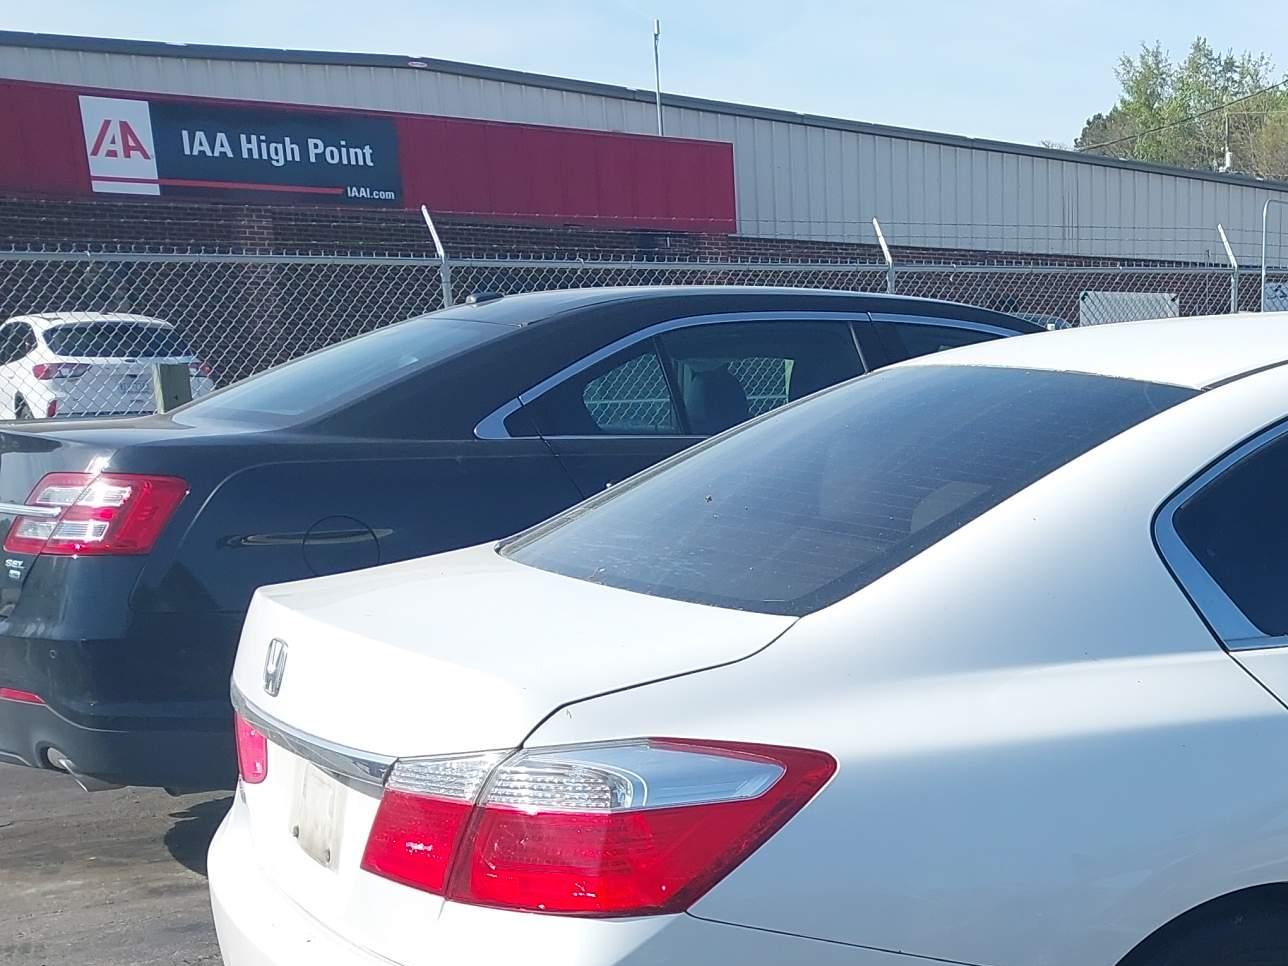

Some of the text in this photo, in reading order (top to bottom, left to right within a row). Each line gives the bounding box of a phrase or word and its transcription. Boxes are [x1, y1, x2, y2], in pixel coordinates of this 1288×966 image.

[181, 129, 374, 167] IAA High Point
[346, 186, 395, 200] IAAI.com
